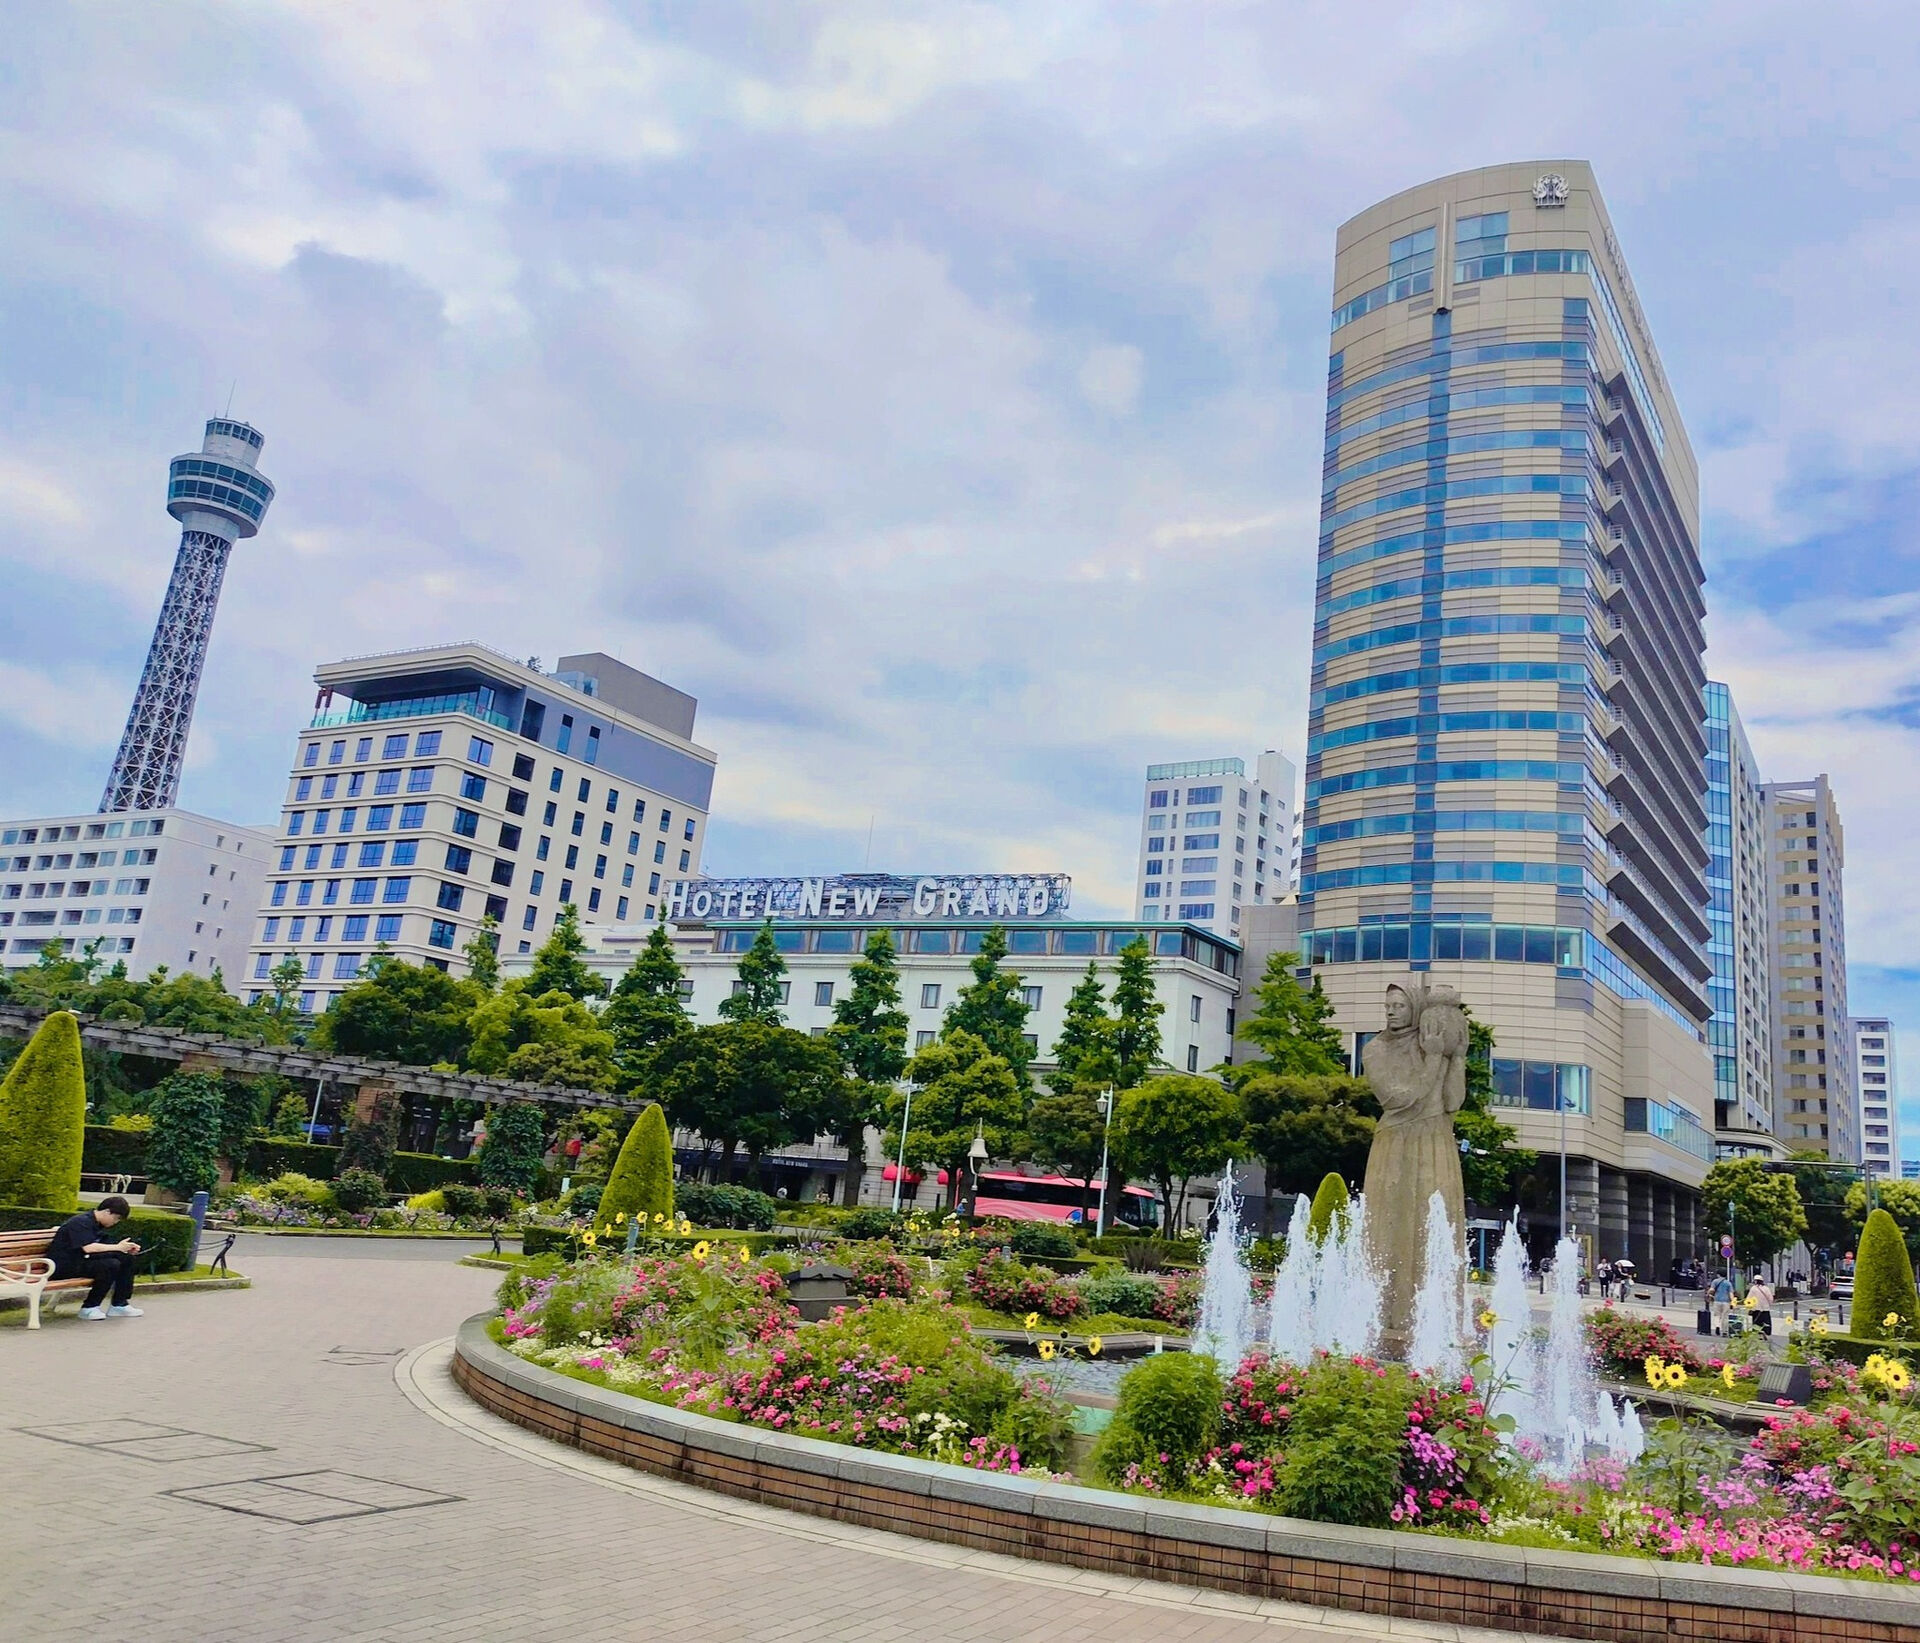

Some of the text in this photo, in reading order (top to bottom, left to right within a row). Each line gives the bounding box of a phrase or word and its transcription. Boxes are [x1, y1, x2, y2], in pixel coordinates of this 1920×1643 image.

[668, 877, 1050, 918] HOTEL NEW GRAND
